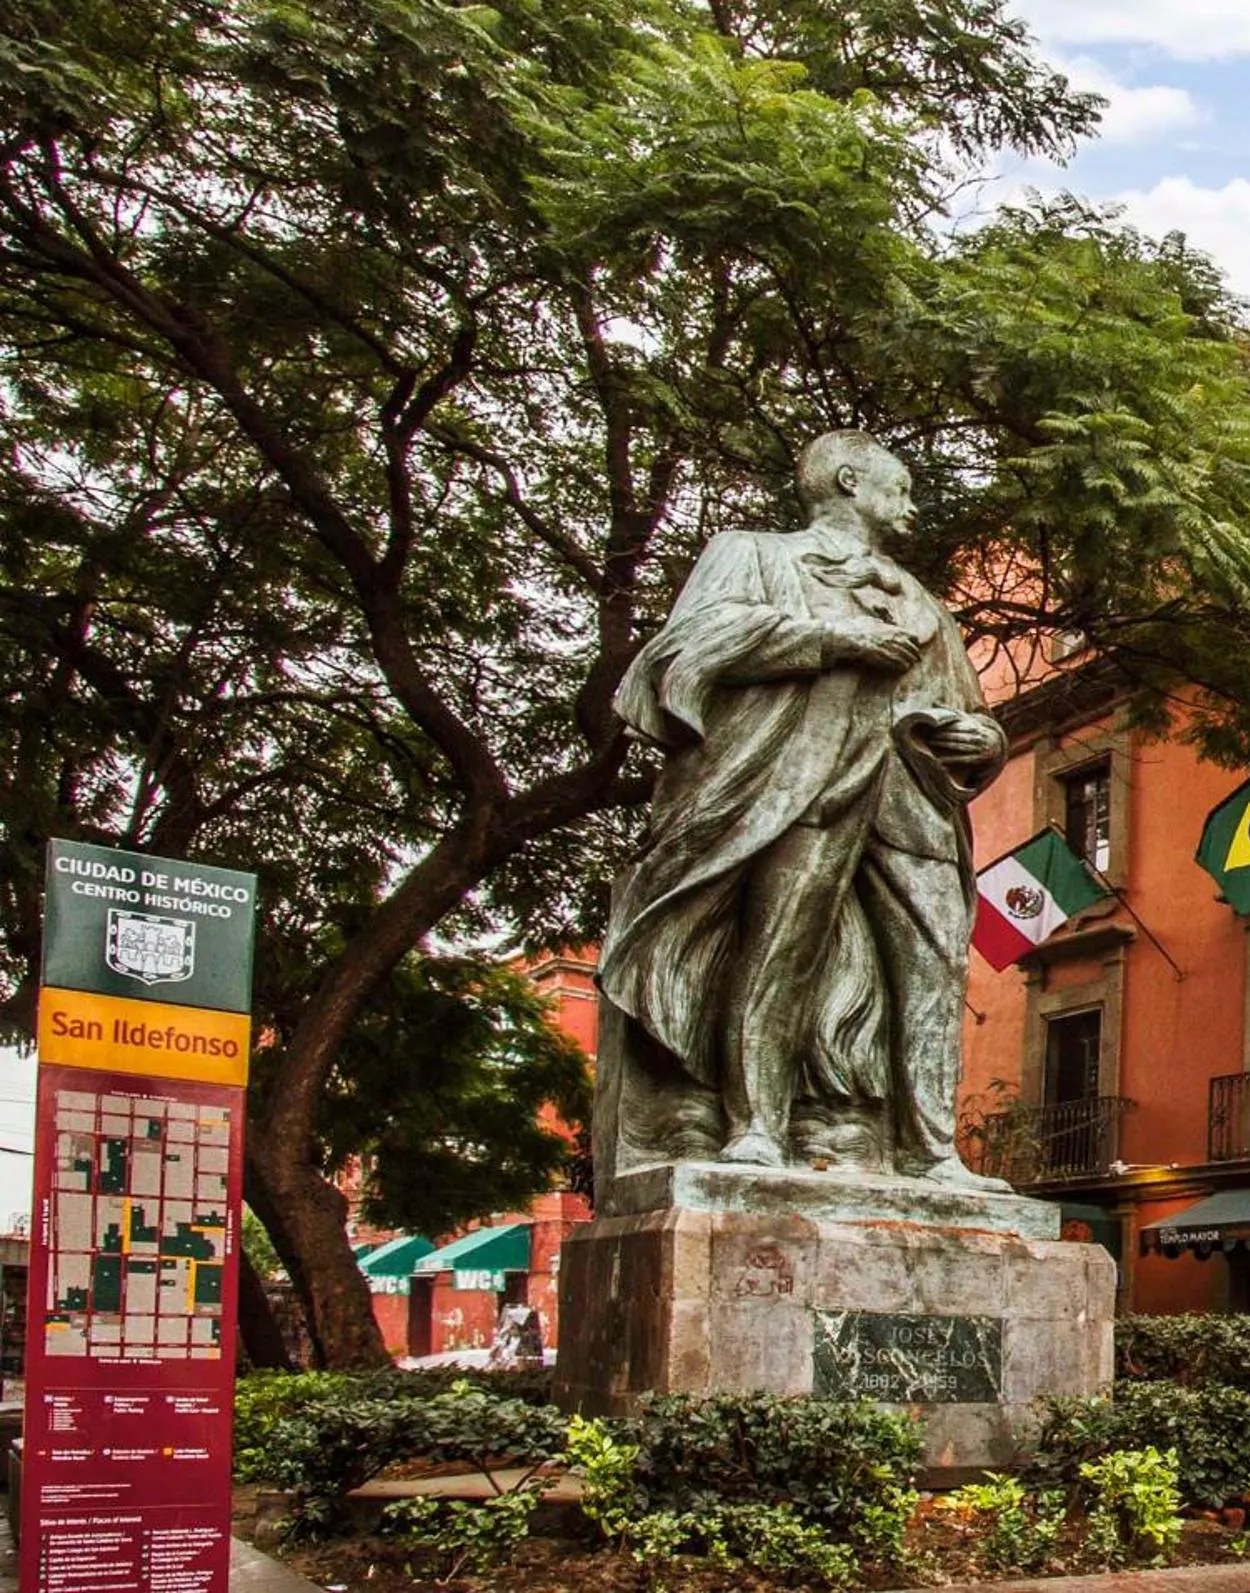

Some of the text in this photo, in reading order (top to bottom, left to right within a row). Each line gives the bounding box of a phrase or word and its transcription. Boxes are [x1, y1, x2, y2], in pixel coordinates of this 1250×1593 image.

[55, 857, 249, 903] CIUDAD DE MÉXICO
[72, 881, 232, 918] CENTRO HISTÓRICO
[51, 1010, 239, 1058] San Ildefonso
[1190, 1230, 1219, 1241] MAYOR
